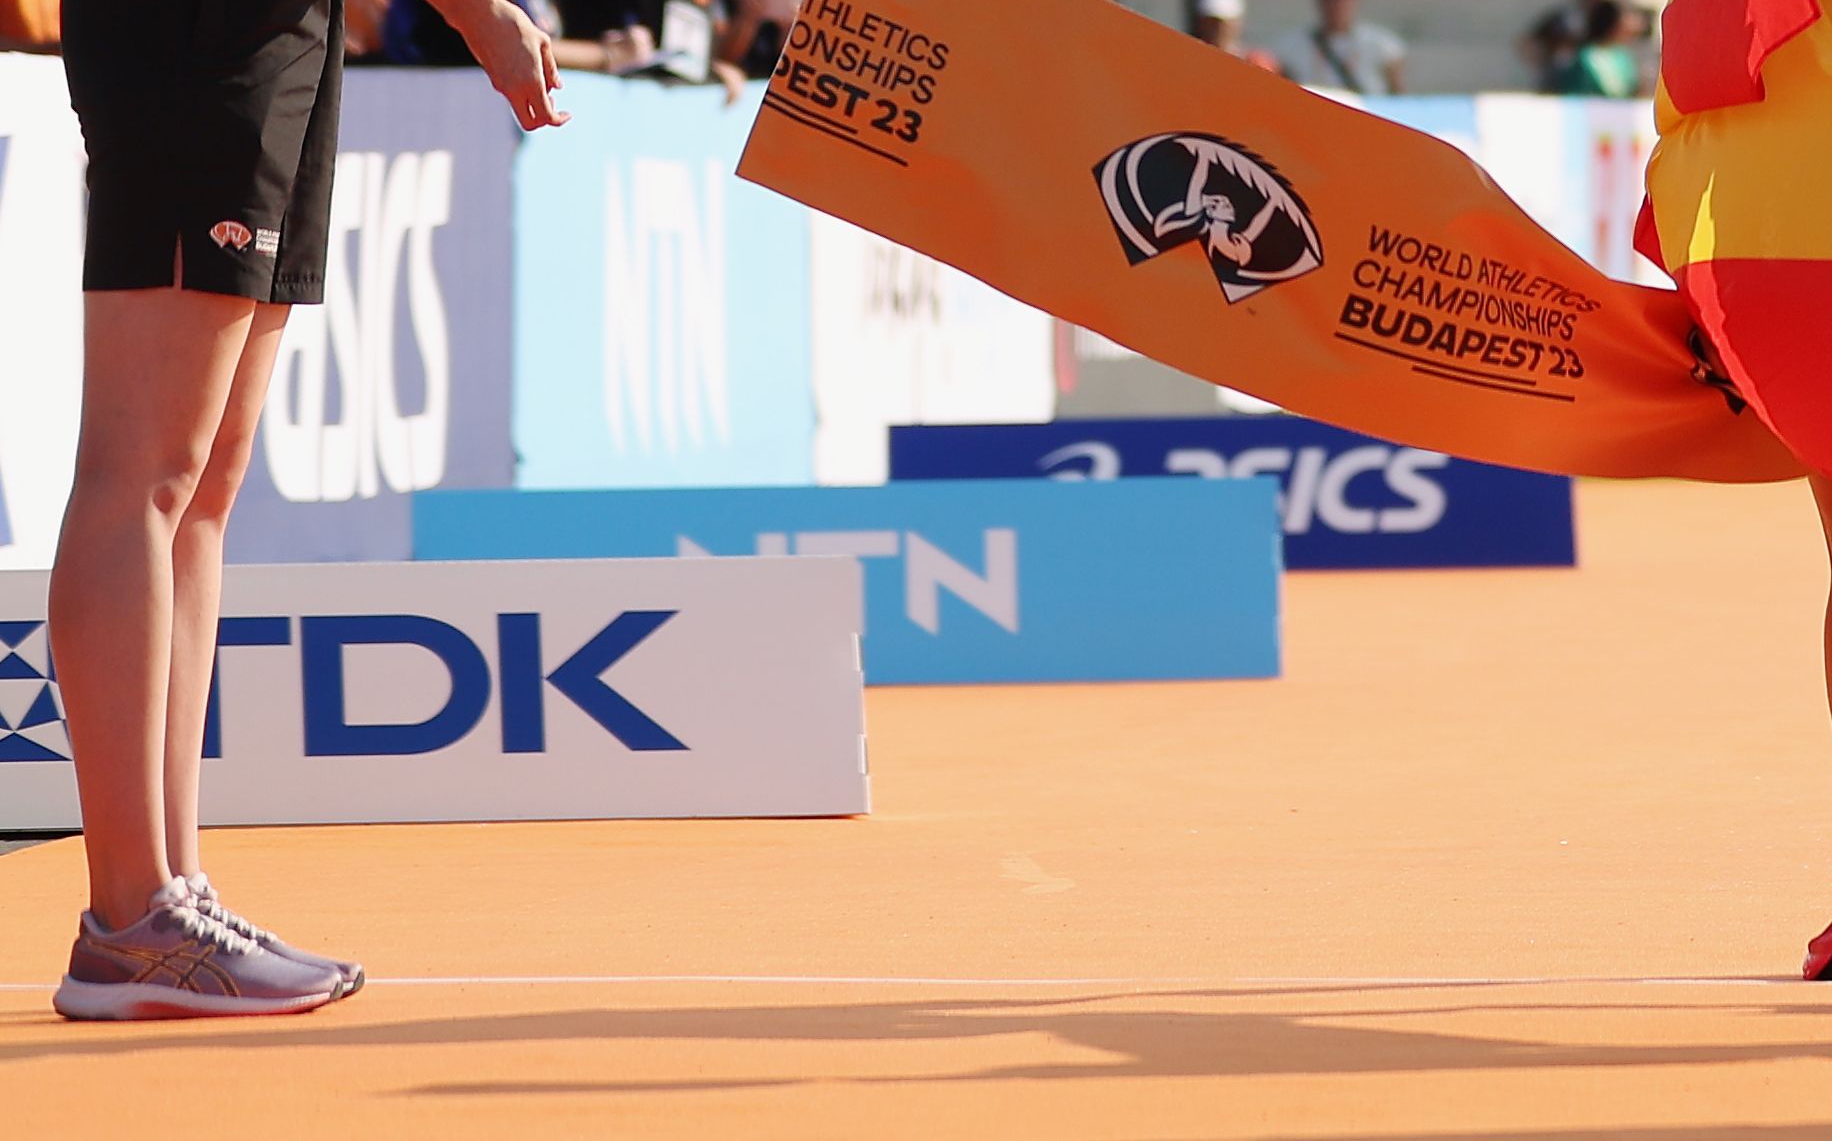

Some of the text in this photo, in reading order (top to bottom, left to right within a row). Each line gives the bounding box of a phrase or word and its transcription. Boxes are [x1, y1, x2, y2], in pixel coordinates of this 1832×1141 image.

[790, 20, 936, 104] ONSHIPS
[870, 99, 923, 143] 23
[602, 154, 732, 460] NTN
[1353, 259, 1577, 341] CHAMPIONSHIPS
[1368, 224, 1601, 312] WORLD ATHLETICS
[1339, 293, 1584, 378] BUDAPEST 23
[1163, 446, 1453, 535] ICS
[675, 527, 1019, 635] TN
